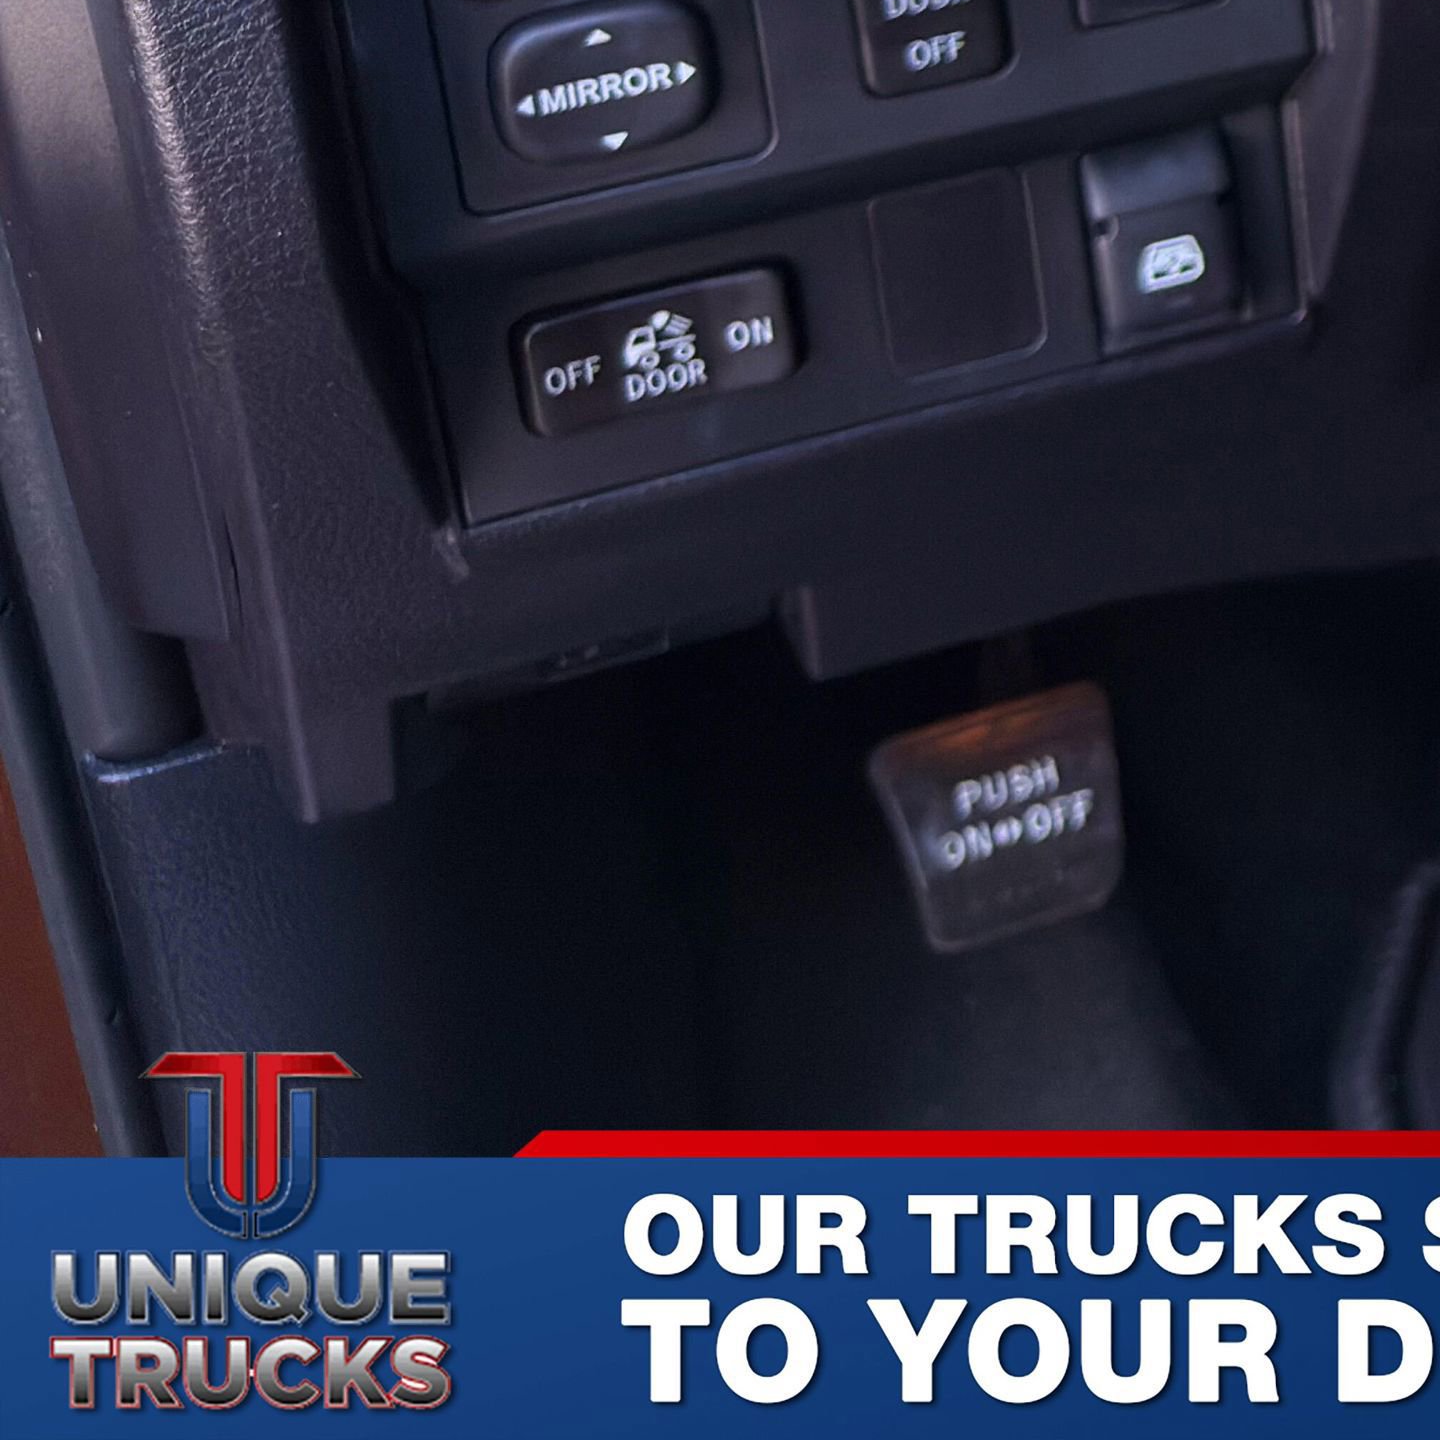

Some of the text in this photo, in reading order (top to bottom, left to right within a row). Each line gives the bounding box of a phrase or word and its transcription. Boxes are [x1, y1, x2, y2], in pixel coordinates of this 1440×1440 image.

[905, 31, 967, 71] OFF
[536, 62, 674, 117] MIRROR
[725, 316, 774, 352] ON
[544, 355, 602, 396] OFF
[624, 358, 708, 403] DOOR
[953, 754, 1060, 820] PUSH
